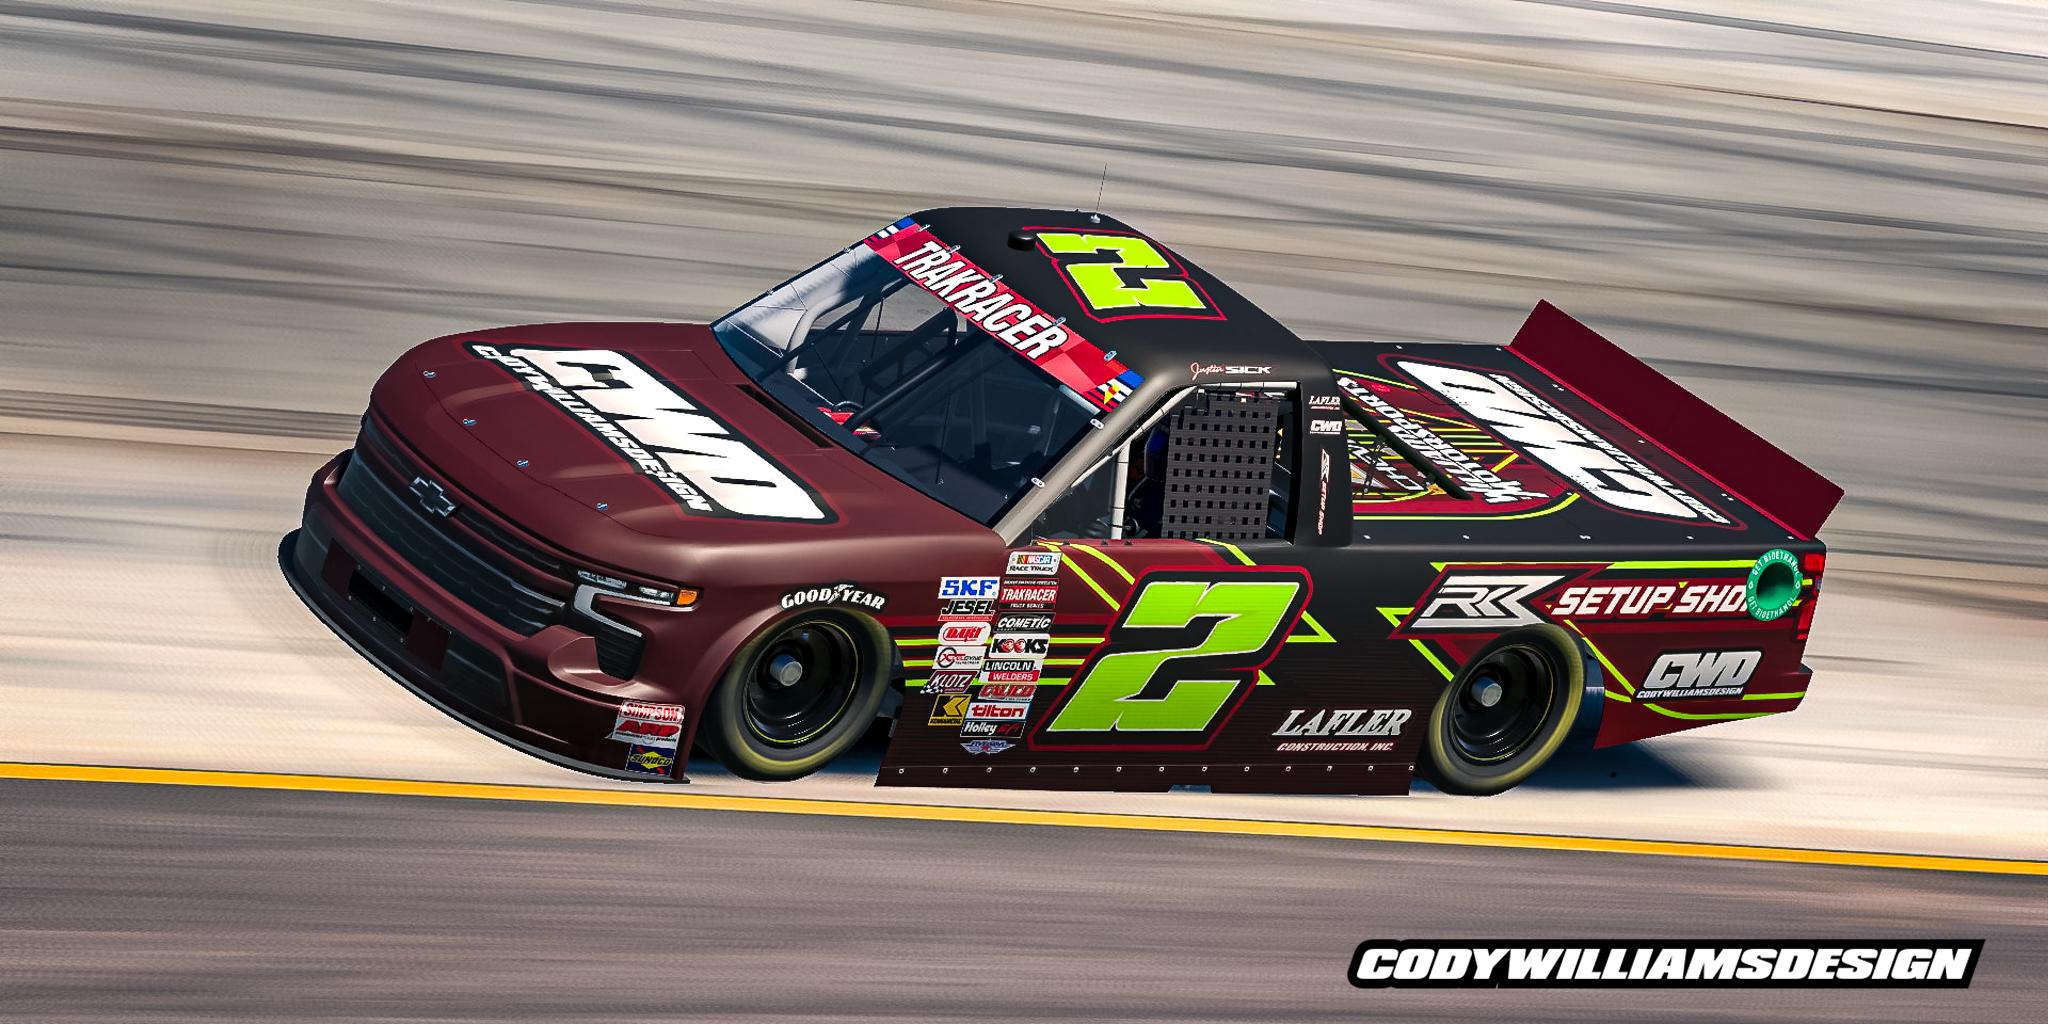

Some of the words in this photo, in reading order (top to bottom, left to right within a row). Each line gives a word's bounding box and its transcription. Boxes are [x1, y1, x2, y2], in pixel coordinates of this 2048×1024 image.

[1036, 233, 1207, 310] 2
[893, 241, 1069, 360] TRAKRACER
[1190, 362, 1225, 381] Justin
[1225, 366, 1272, 374] SICK
[1309, 395, 1340, 405] LAFLER
[472, 344, 714, 512] CODYWILLIAMSDESIGN
[1310, 420, 1342, 432] CWD
[509, 349, 825, 520] CWD
[1752, 559, 1763, 575] GET
[942, 579, 998, 596] SKF
[1001, 588, 1057, 601] TRAKRACER
[941, 600, 994, 615] JESEL
[1551, 586, 1676, 615] SETUP
[1748, 596, 1758, 610] GET
[1755, 597, 1795, 620] BIOETHANOL
[998, 615, 1051, 629] COMETIC
[991, 638, 1049, 654] KOOKS
[1046, 581, 1299, 732] 2
[984, 660, 1032, 671] LINCOLN
[1643, 650, 1762, 689] CWD
[931, 673, 973, 688] KLOTZ
[992, 672, 1034, 681] WELDERS
[1636, 686, 1744, 699] CODYWILLIAMSDESIGN
[624, 702, 680, 721] SIMPSON
[971, 704, 1026, 718] tilton
[616, 719, 681, 738] ARP
[963, 721, 998, 736] Holley
[1271, 708, 1412, 736] LAFLER
[1276, 742, 1368, 752] CONSTRUCTION,
[1369, 742, 1395, 752] INC.
[629, 753, 673, 767] SUNOCO
